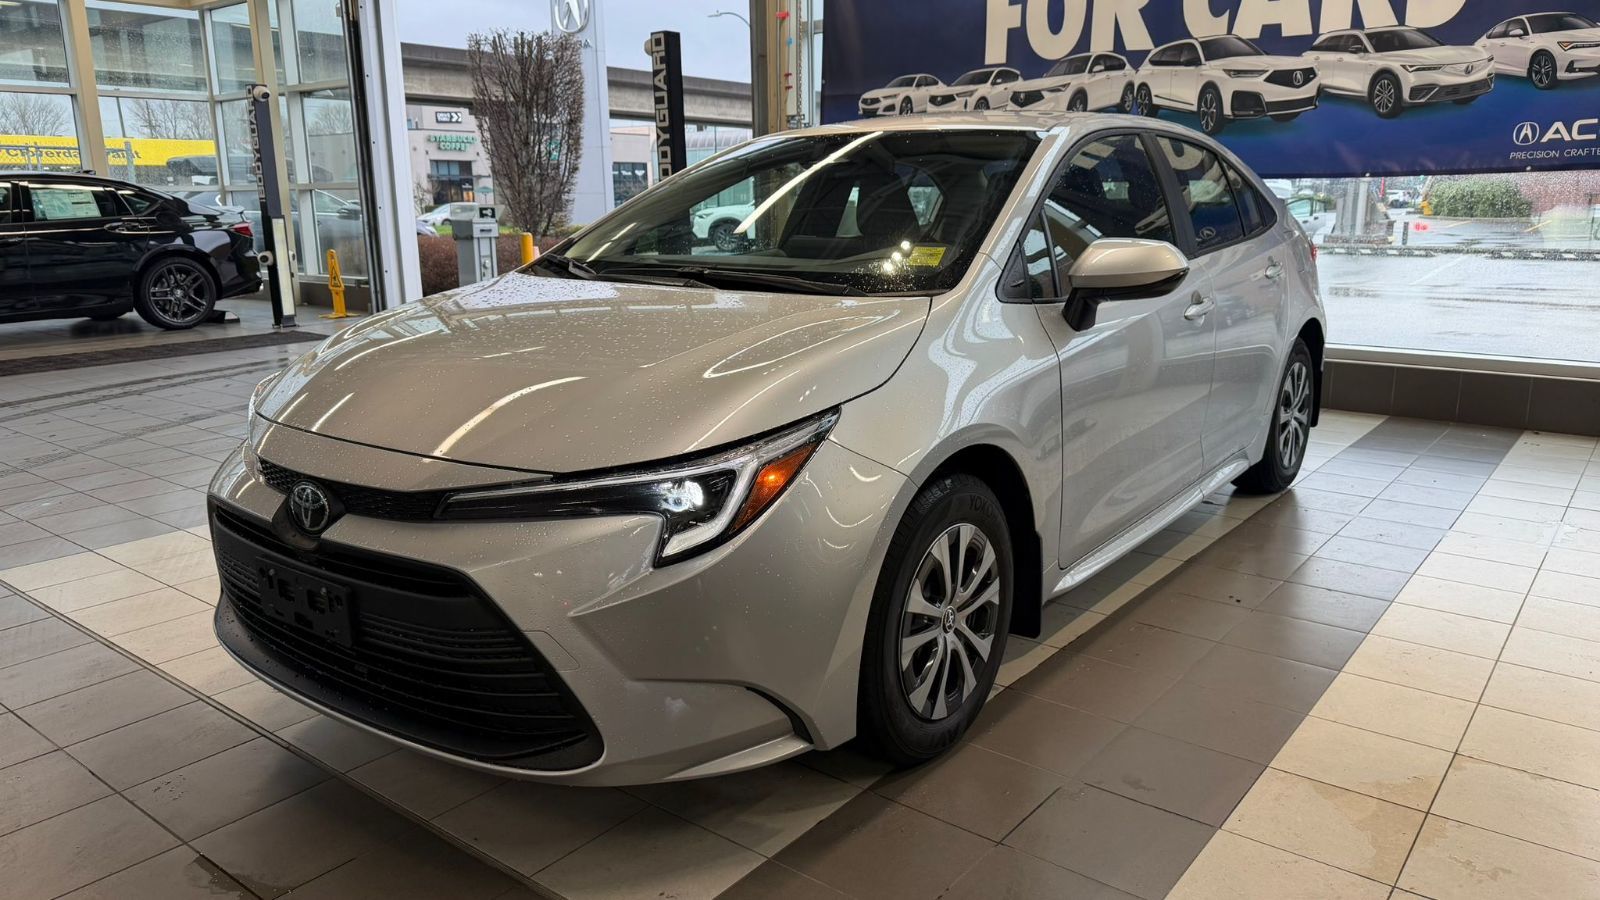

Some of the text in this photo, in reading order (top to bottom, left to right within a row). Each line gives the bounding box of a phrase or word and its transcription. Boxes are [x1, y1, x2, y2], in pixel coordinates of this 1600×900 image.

[985, 0, 1155, 65] FOR
[651, 32, 673, 181] ODYGUARD
[1509, 150, 1560, 160] PRECISION
